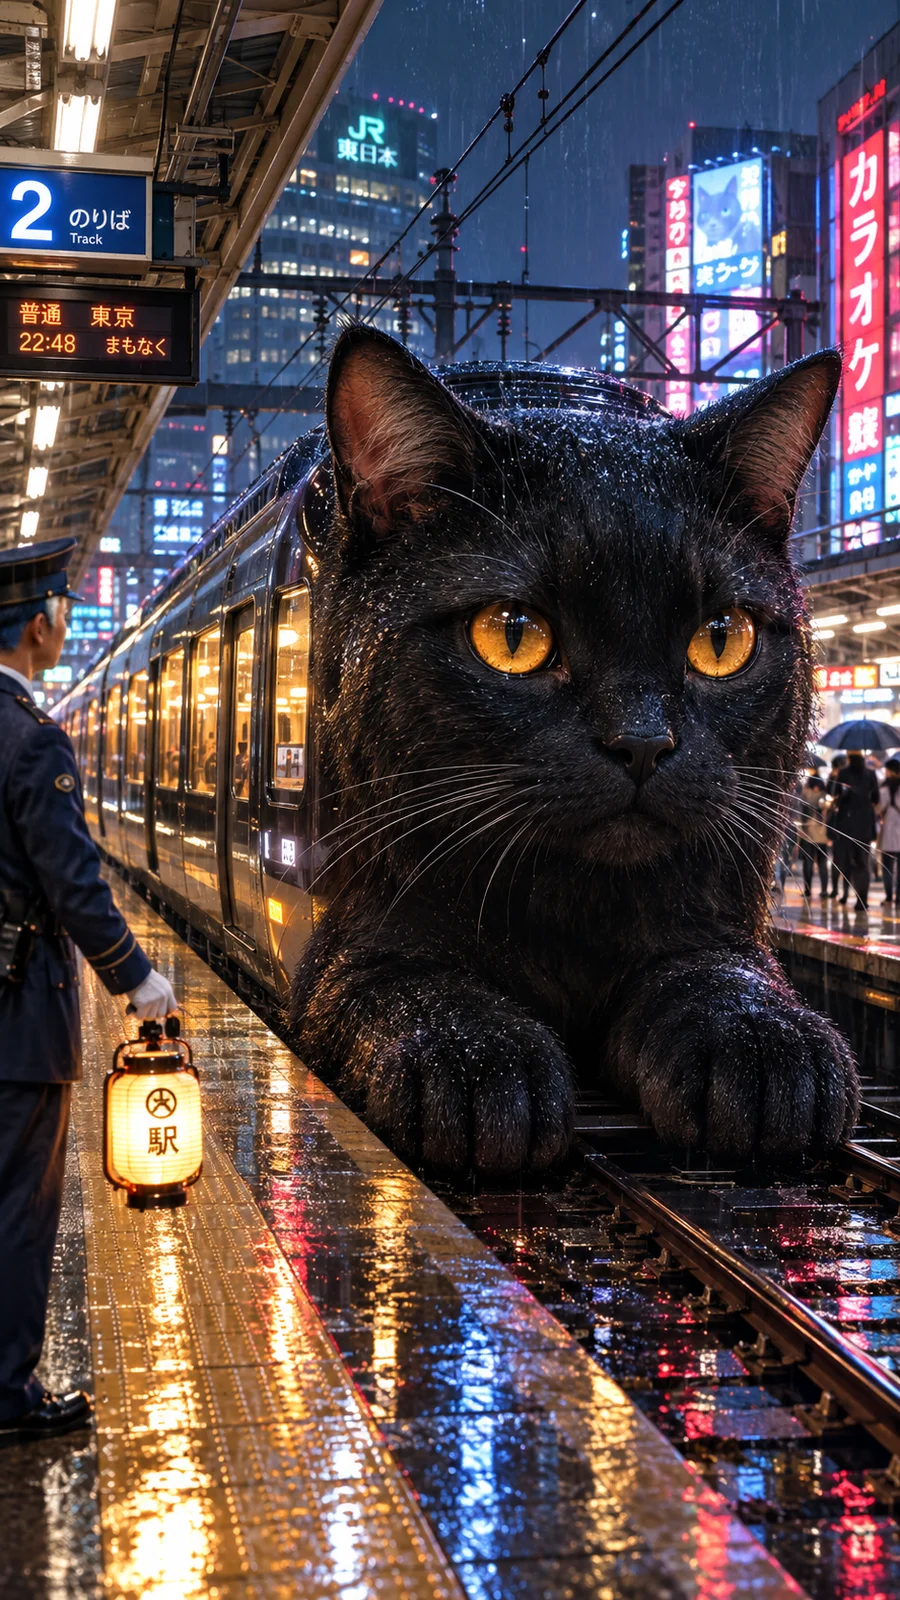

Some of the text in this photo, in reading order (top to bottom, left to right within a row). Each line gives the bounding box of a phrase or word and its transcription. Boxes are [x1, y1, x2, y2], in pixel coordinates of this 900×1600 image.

[348, 115, 385, 145] JR
[337, 138, 398, 168] 東日本
[11, 180, 53, 241] 2
[69, 208, 131, 230] のりば
[70, 233, 103, 245] Track
[19, 302, 135, 328] 普通 東京
[19, 332, 167, 356] 22:48 まもなく
[148, 1125, 179, 1156] 駅
